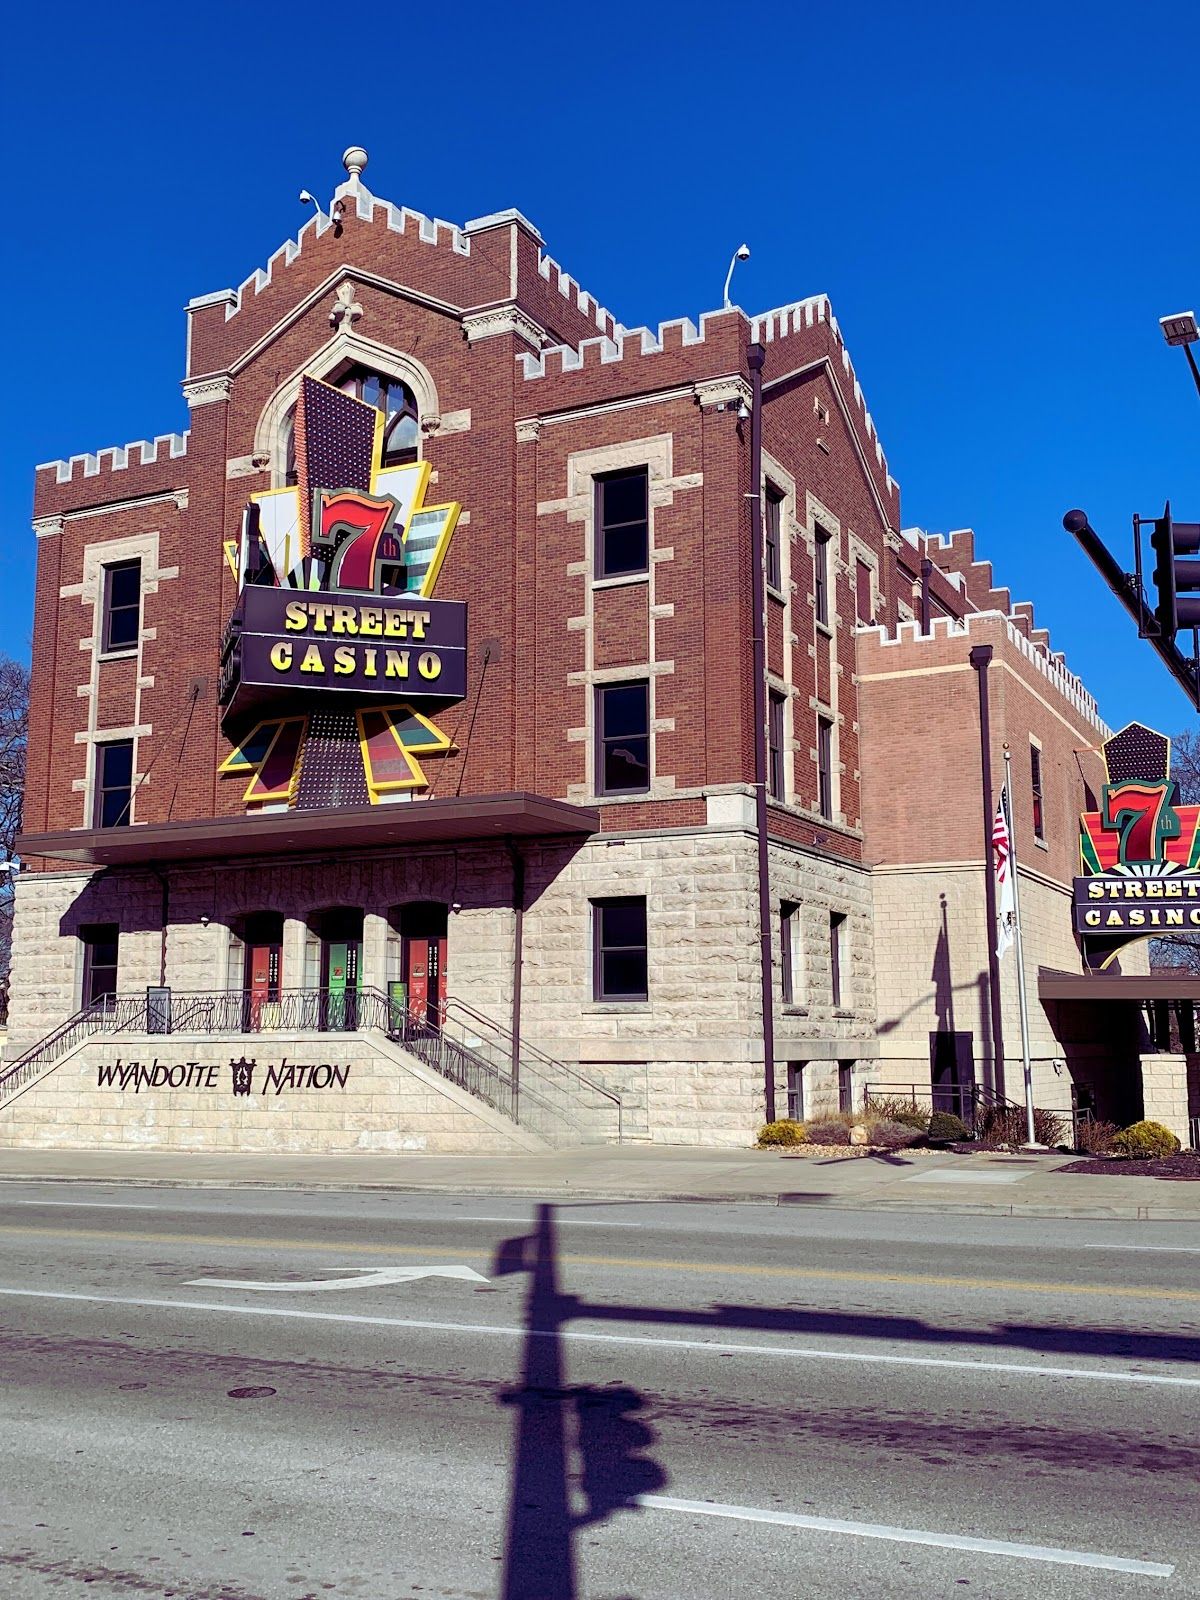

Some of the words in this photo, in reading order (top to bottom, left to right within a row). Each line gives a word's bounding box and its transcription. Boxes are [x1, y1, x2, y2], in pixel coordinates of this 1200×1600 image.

[285, 601, 430, 638] STREET
[270, 642, 442, 679] CASINO
[1088, 880, 1200, 899] STREET
[97, 1058, 220, 1094] WYANDOTTE
[262, 1058, 351, 1096] NATION
